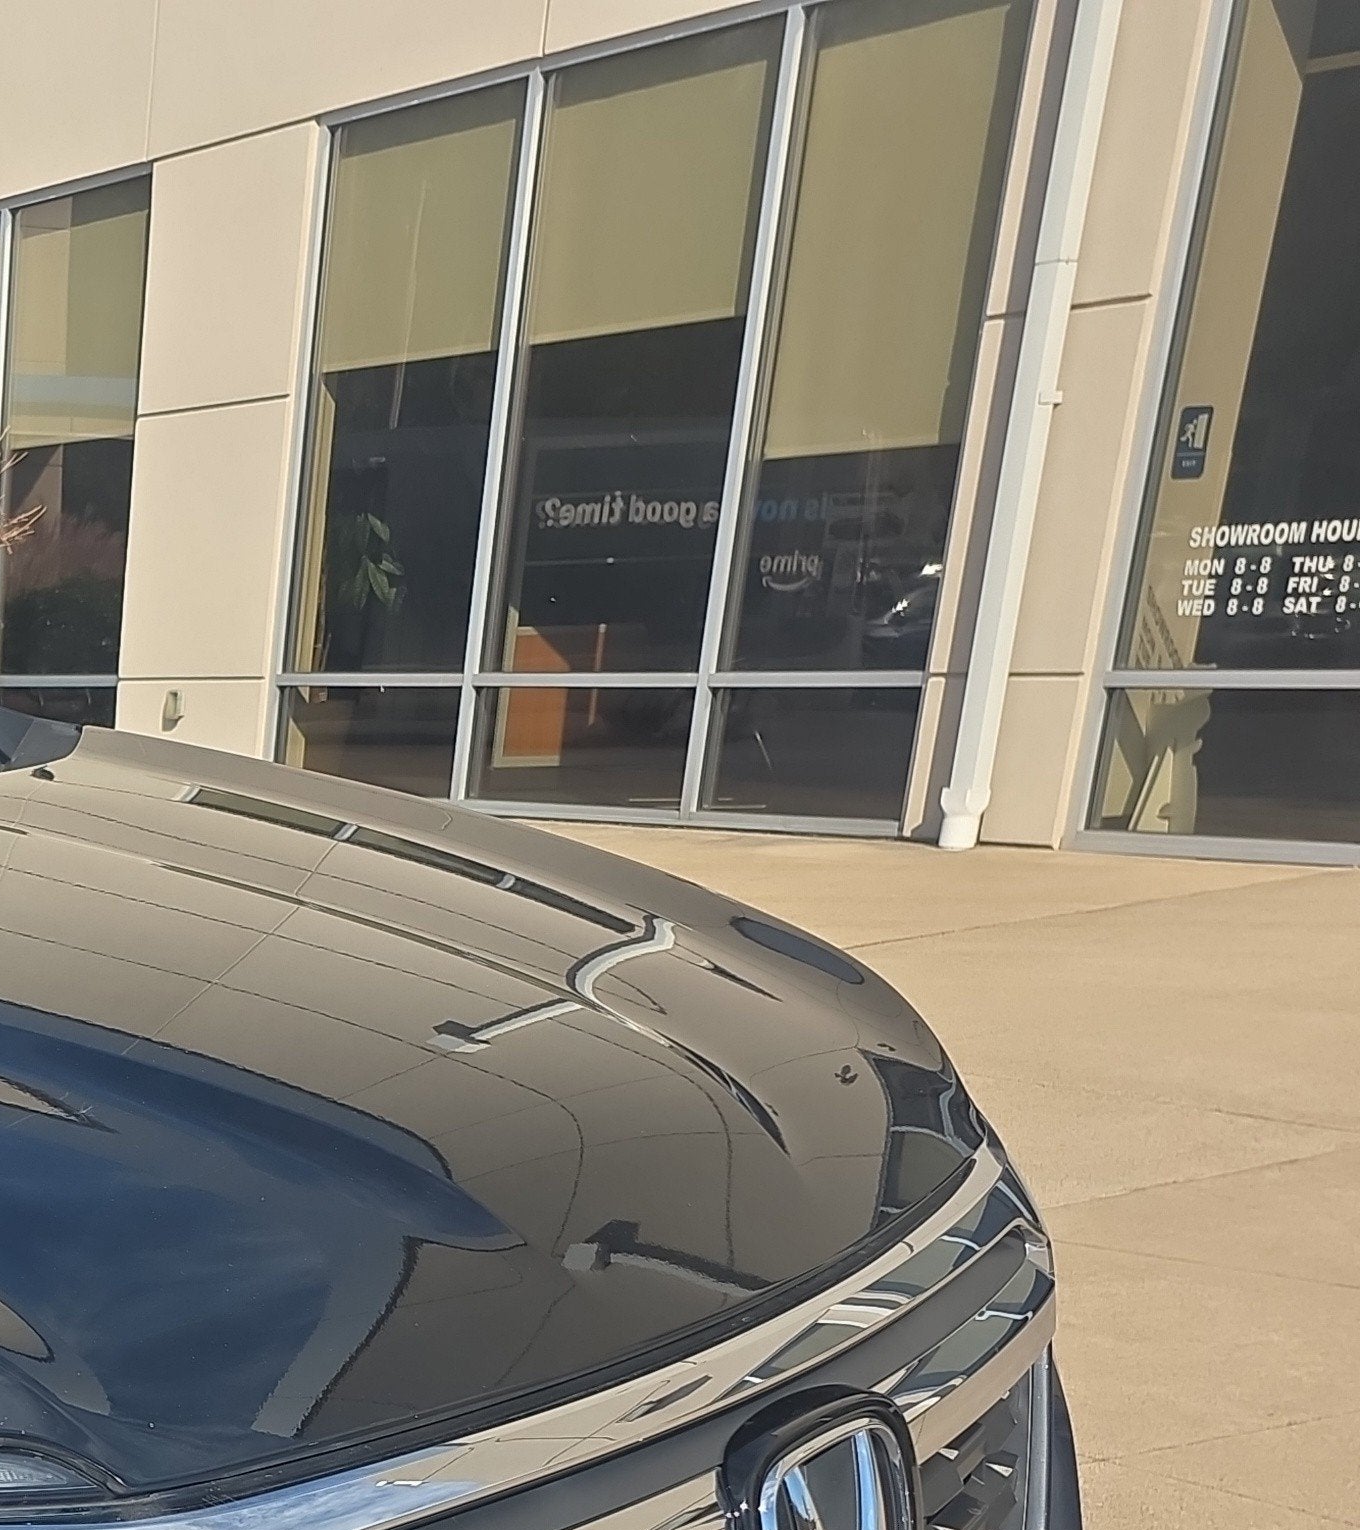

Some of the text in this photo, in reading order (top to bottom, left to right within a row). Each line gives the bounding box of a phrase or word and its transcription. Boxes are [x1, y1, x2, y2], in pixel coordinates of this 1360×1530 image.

[1189, 522, 1307, 547] SHOWROOM
[1184, 558, 1225, 576] MON
[1292, 555, 1332, 573] THU
[1181, 578, 1217, 596] TUE
[1286, 576, 1319, 594] FRI
[1177, 598, 1215, 616] WED
[1282, 596, 1322, 614] SAT
